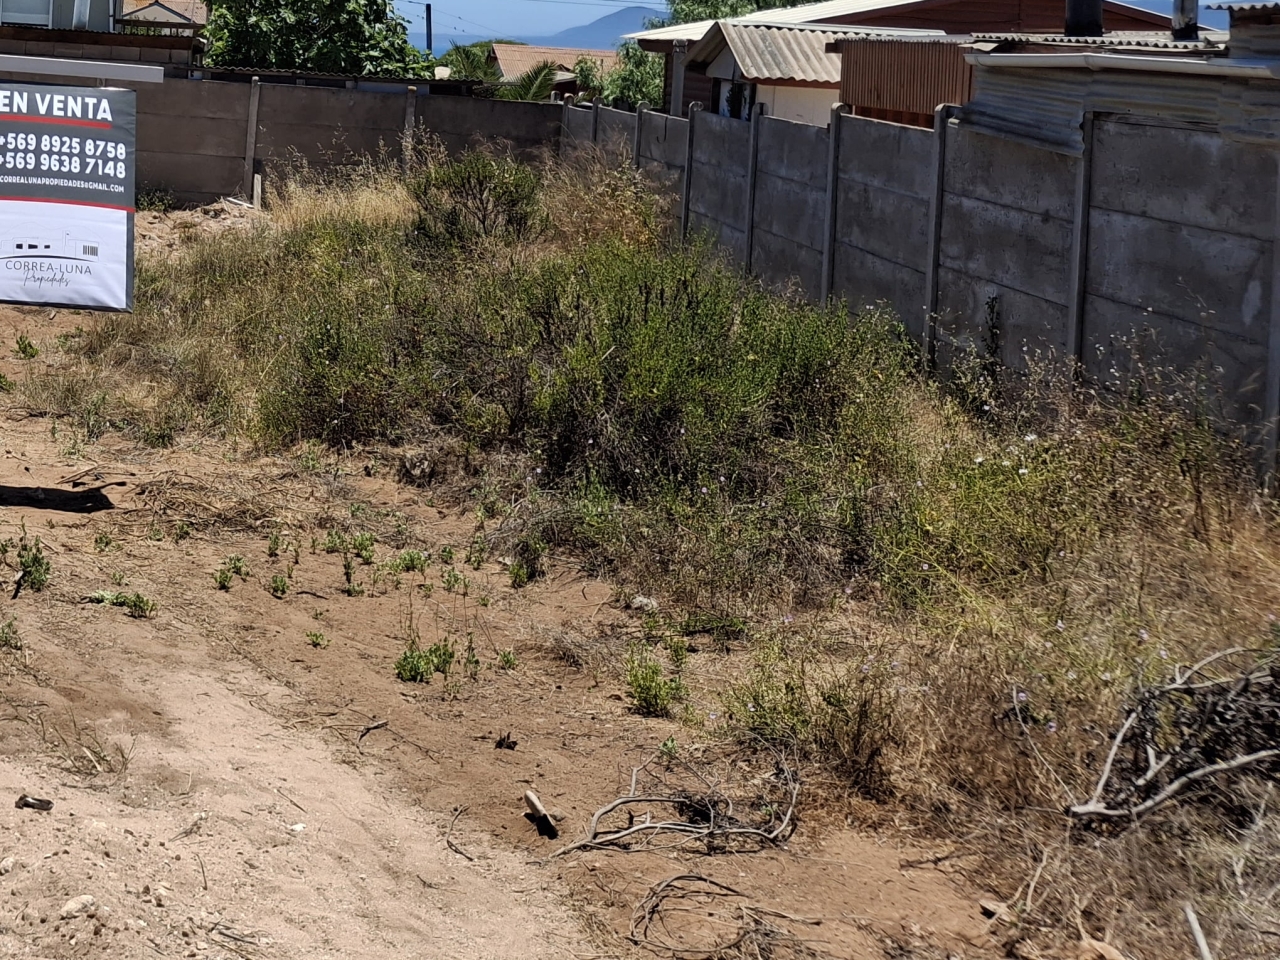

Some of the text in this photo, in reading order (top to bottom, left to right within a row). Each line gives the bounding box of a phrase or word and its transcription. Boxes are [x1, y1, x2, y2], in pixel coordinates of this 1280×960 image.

[35, 93, 113, 121] VENTA
[41, 135, 81, 154] 8925
[85, 139, 126, 159] 8758
[40, 153, 81, 173] 9638
[85, 158, 126, 178] 7148
[5, 260, 92, 275] CORREA-LUNA
